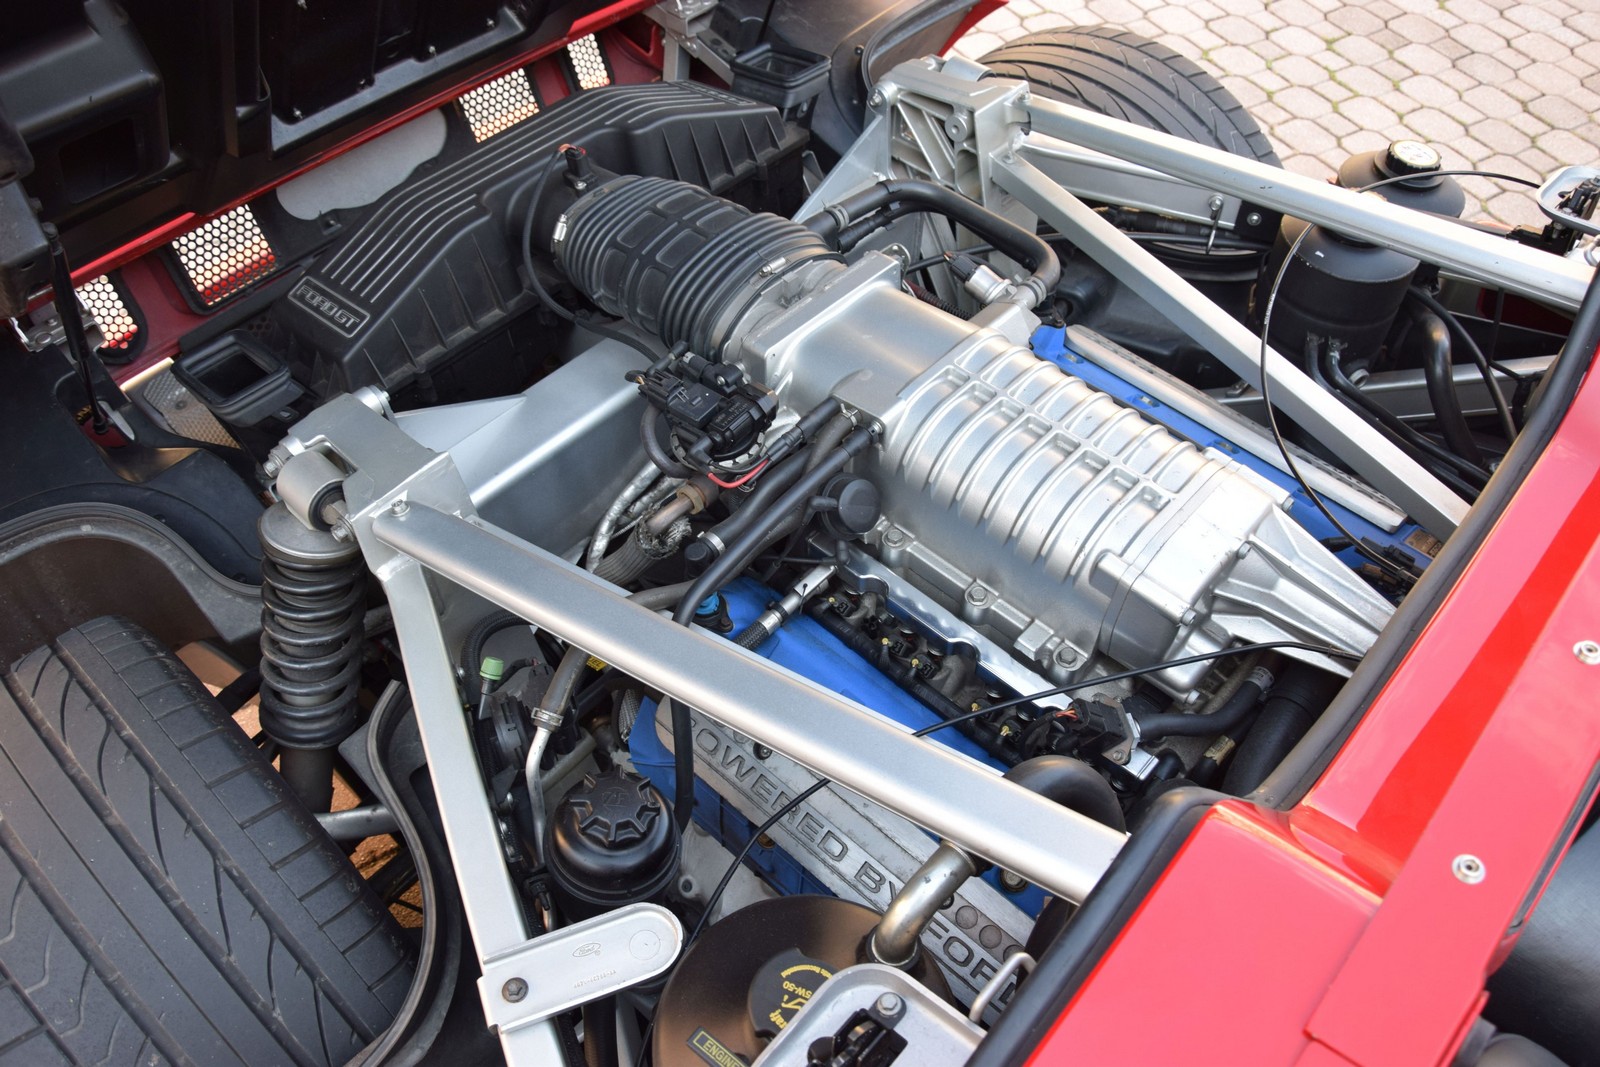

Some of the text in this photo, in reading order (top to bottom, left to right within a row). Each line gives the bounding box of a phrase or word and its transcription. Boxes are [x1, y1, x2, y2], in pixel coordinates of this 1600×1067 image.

[296, 284, 361, 328] FORD GT
[689, 717, 849, 862] OWERED
[782, 980, 813, 999] 5W-50
